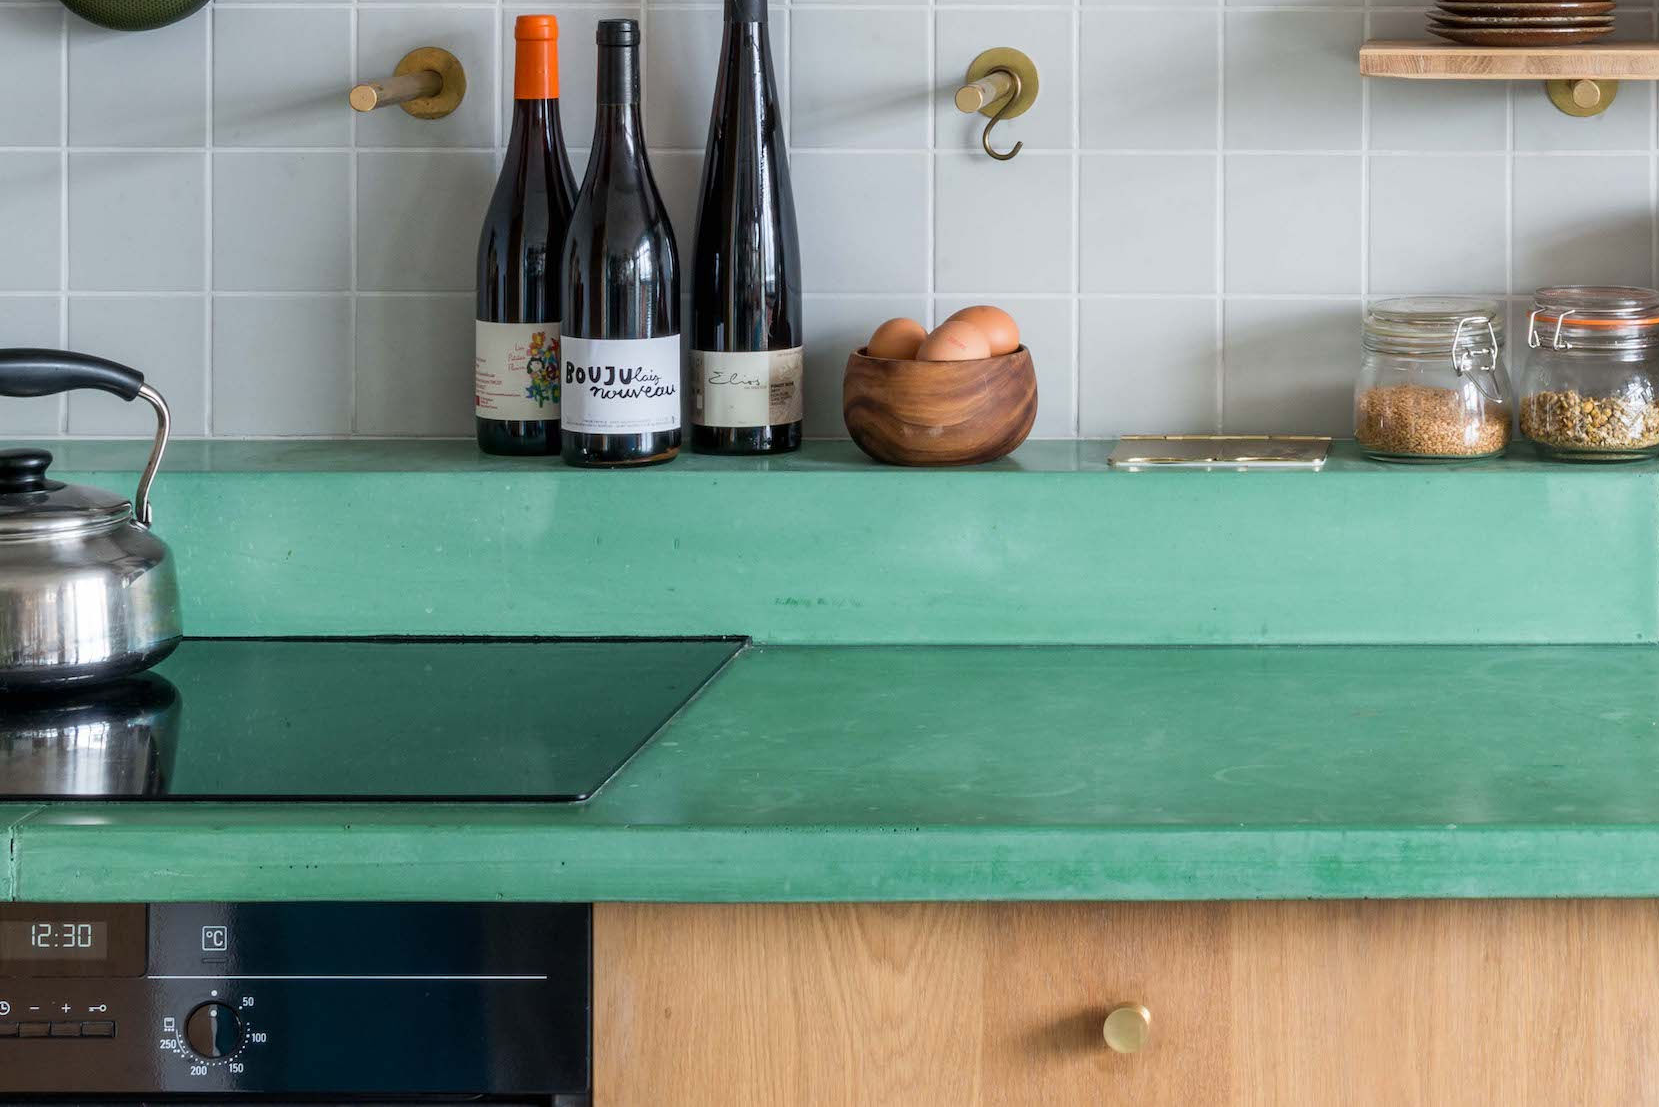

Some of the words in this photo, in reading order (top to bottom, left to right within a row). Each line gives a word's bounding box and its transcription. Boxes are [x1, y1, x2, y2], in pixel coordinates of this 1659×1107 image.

[589, 384, 676, 399] nouveau
[31, 923, 92, 948] 12:30
[242, 996, 255, 1008] 50
[251, 1032, 267, 1043] 100
[159, 1039, 177, 1050] 250
[190, 1065, 208, 1076] 200
[228, 1062, 244, 1074] 150
